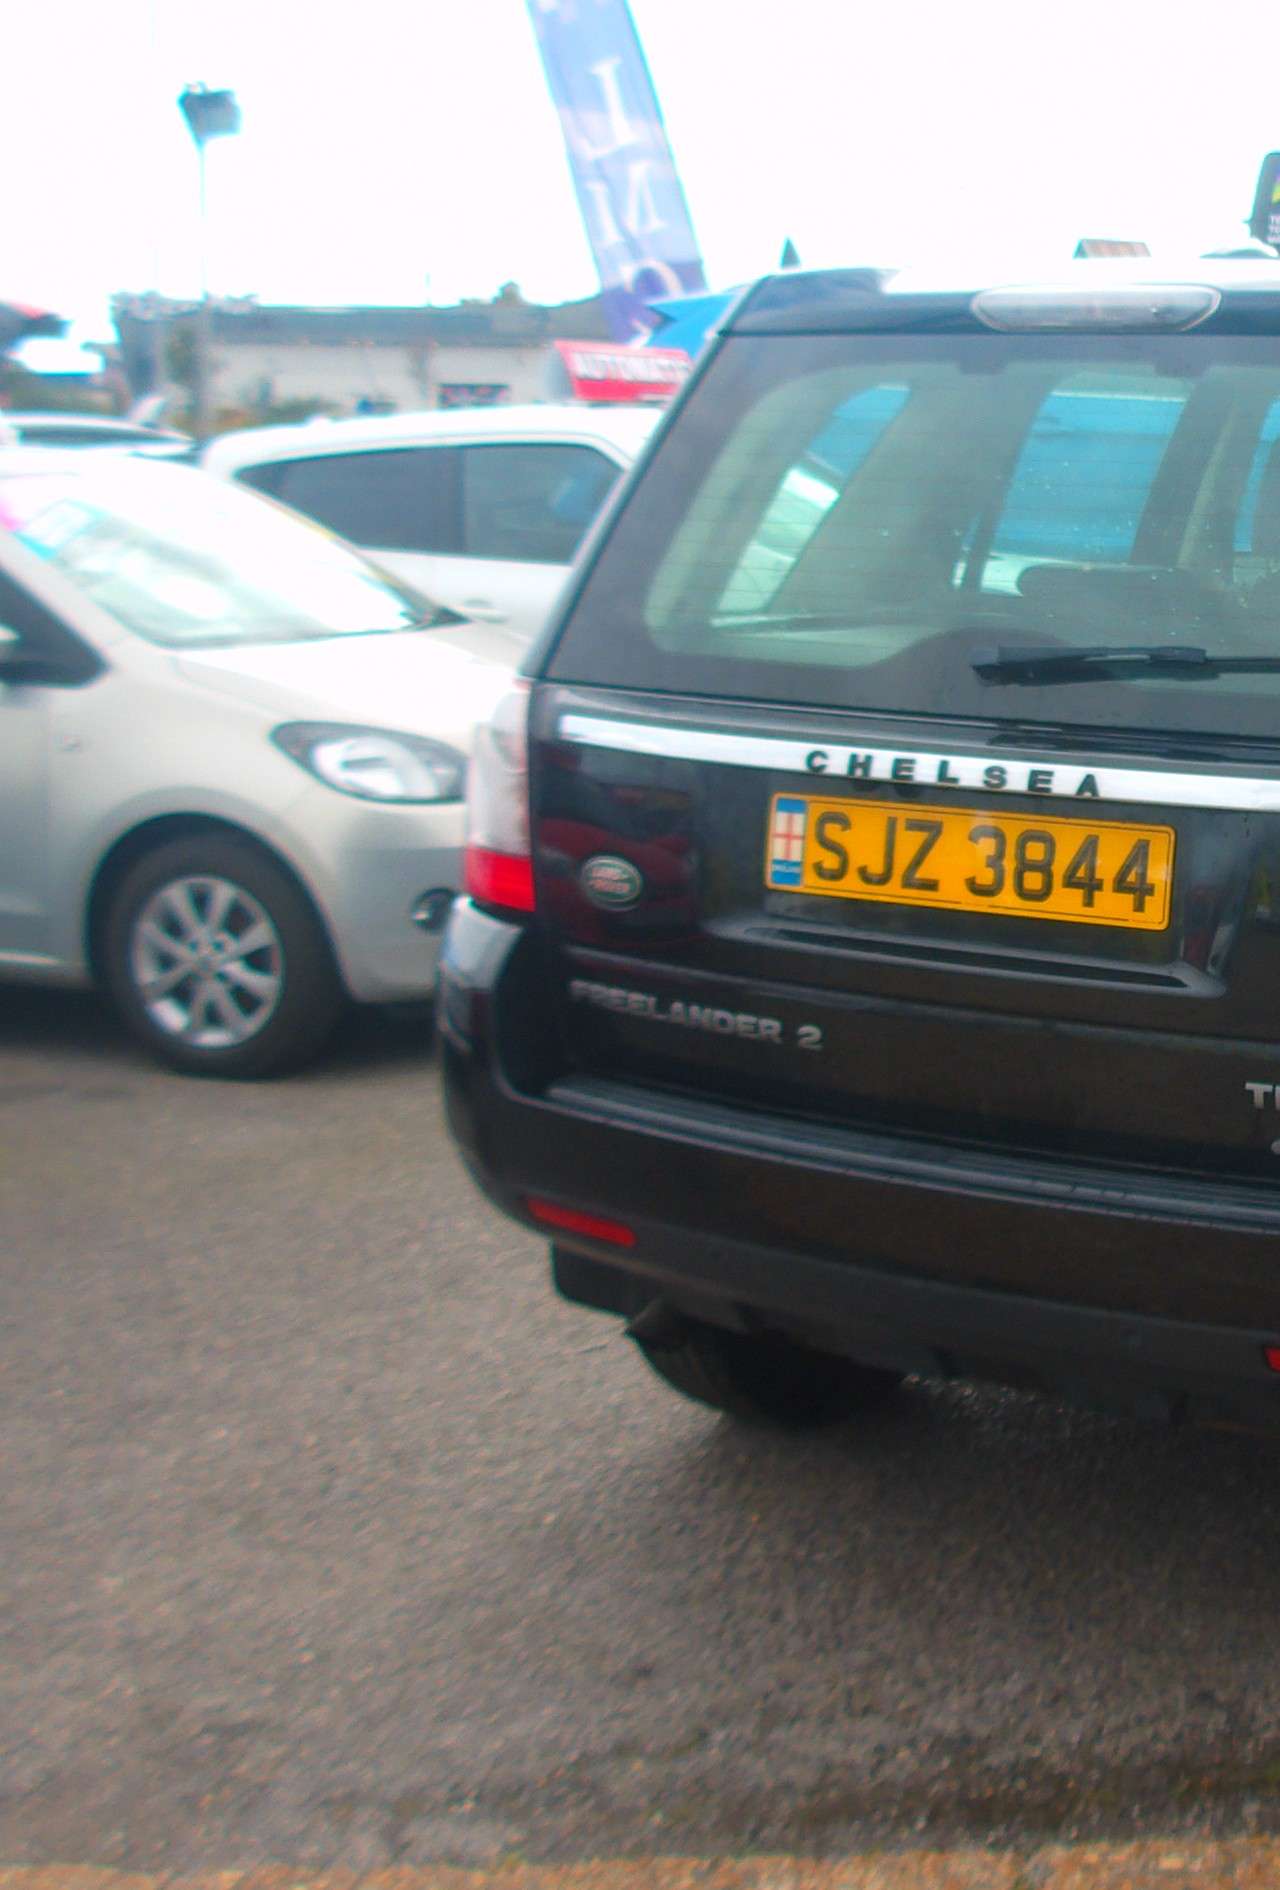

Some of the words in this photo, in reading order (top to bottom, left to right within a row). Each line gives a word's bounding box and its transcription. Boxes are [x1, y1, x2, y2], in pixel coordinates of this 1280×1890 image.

[804, 749, 1101, 798] CHELSEA
[811, 810, 944, 893] SJZ
[964, 824, 1156, 913] 3844
[570, 979, 784, 1044] FREELANDER
[796, 1024, 823, 1051] 2
